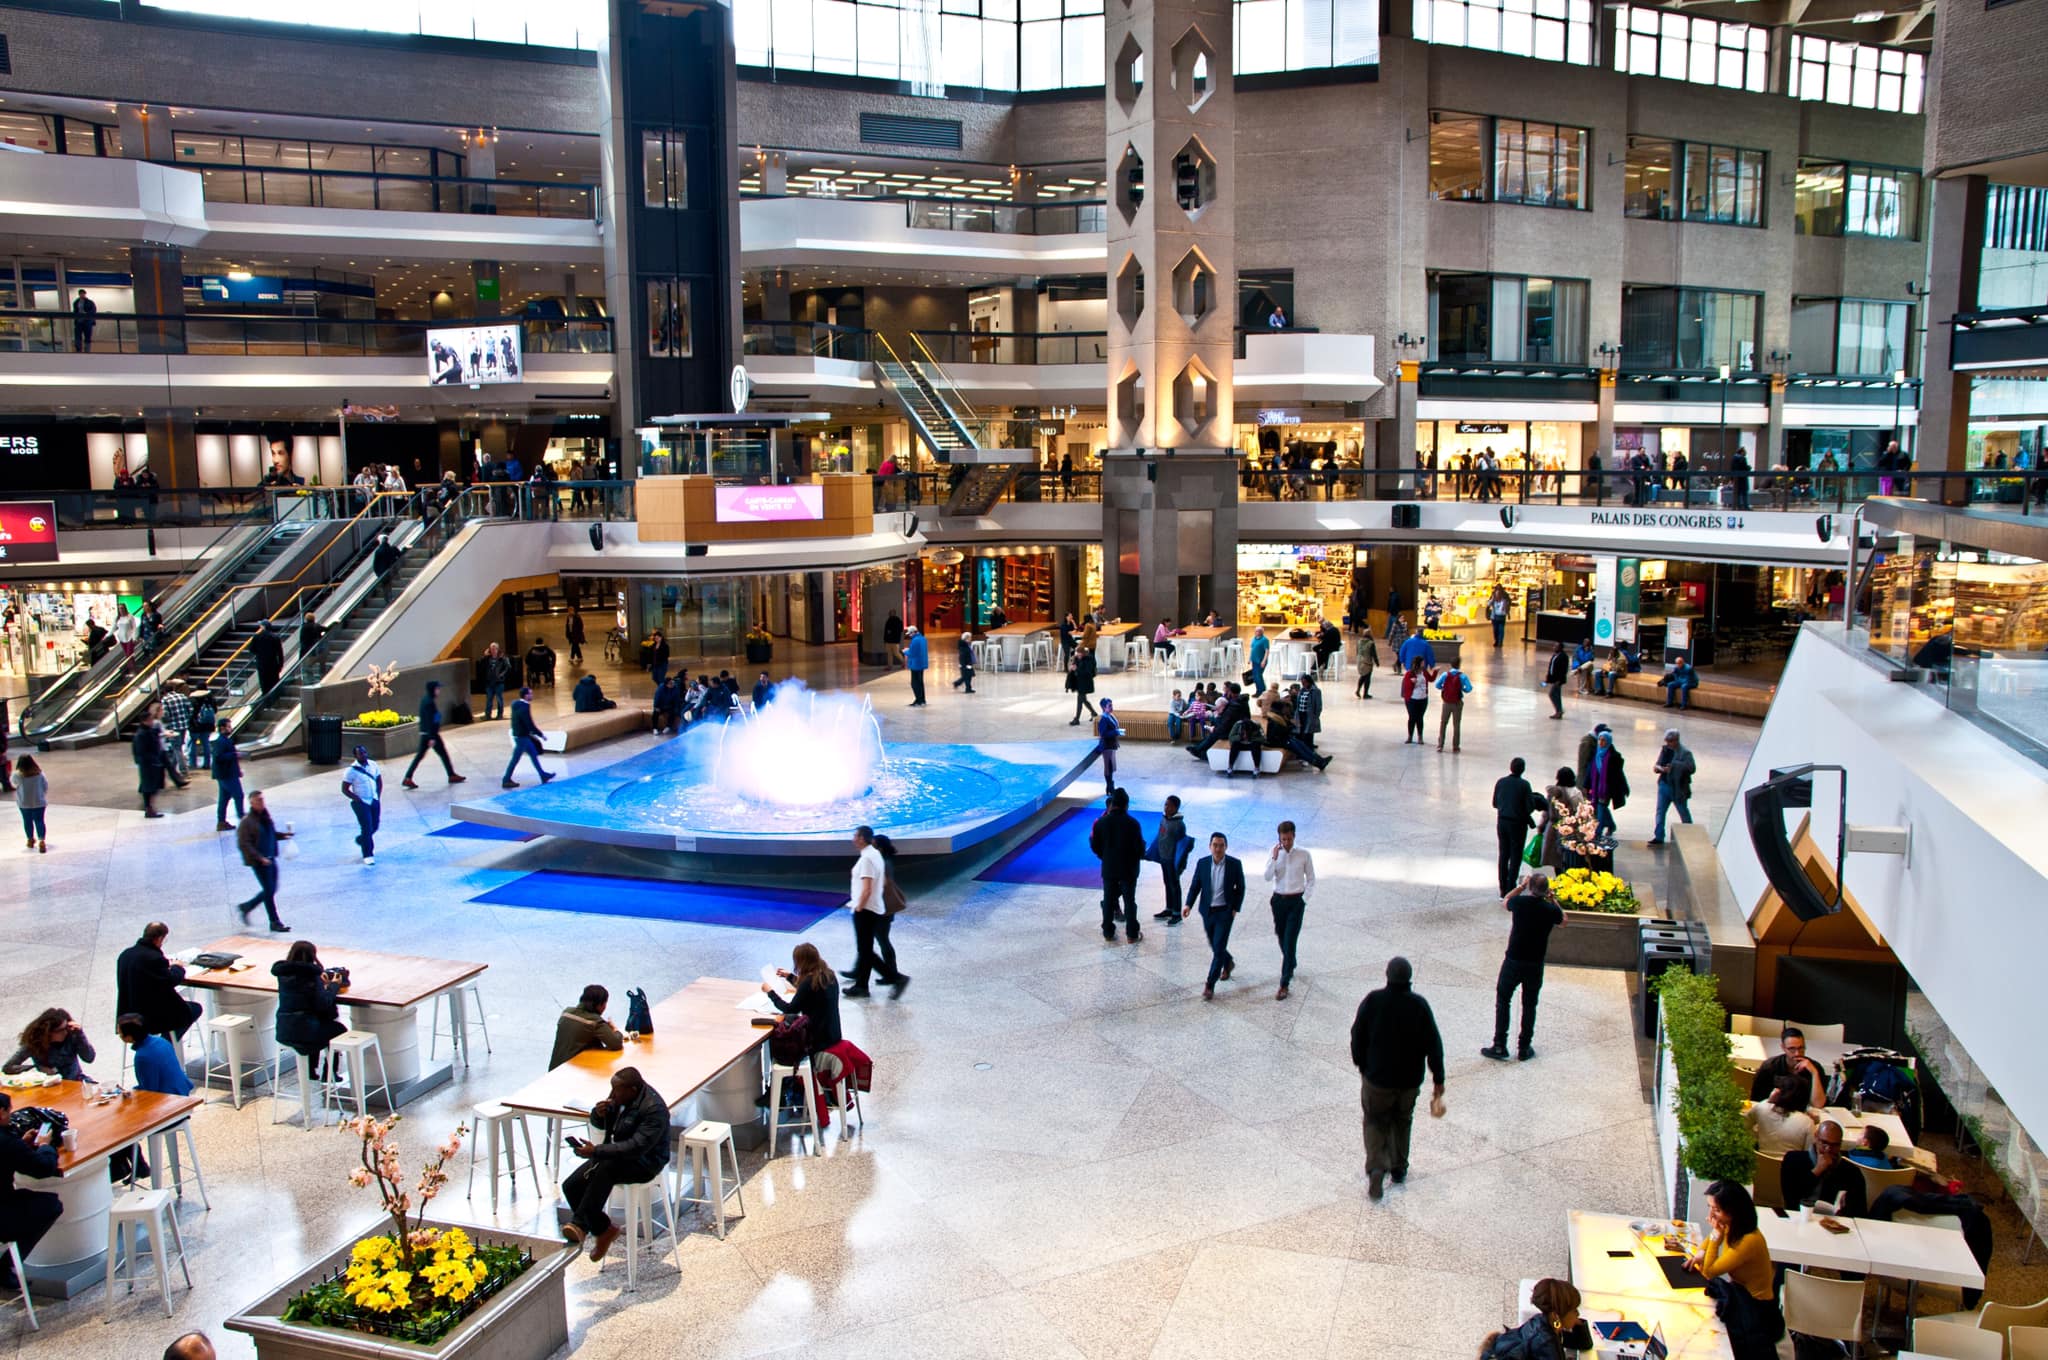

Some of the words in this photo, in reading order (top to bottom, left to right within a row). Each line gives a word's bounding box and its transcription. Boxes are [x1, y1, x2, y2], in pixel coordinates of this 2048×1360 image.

[1591, 511, 1631, 525] PALAIS
[1633, 512, 1657, 526] DES
[1659, 512, 1722, 529] CONGRÈS
